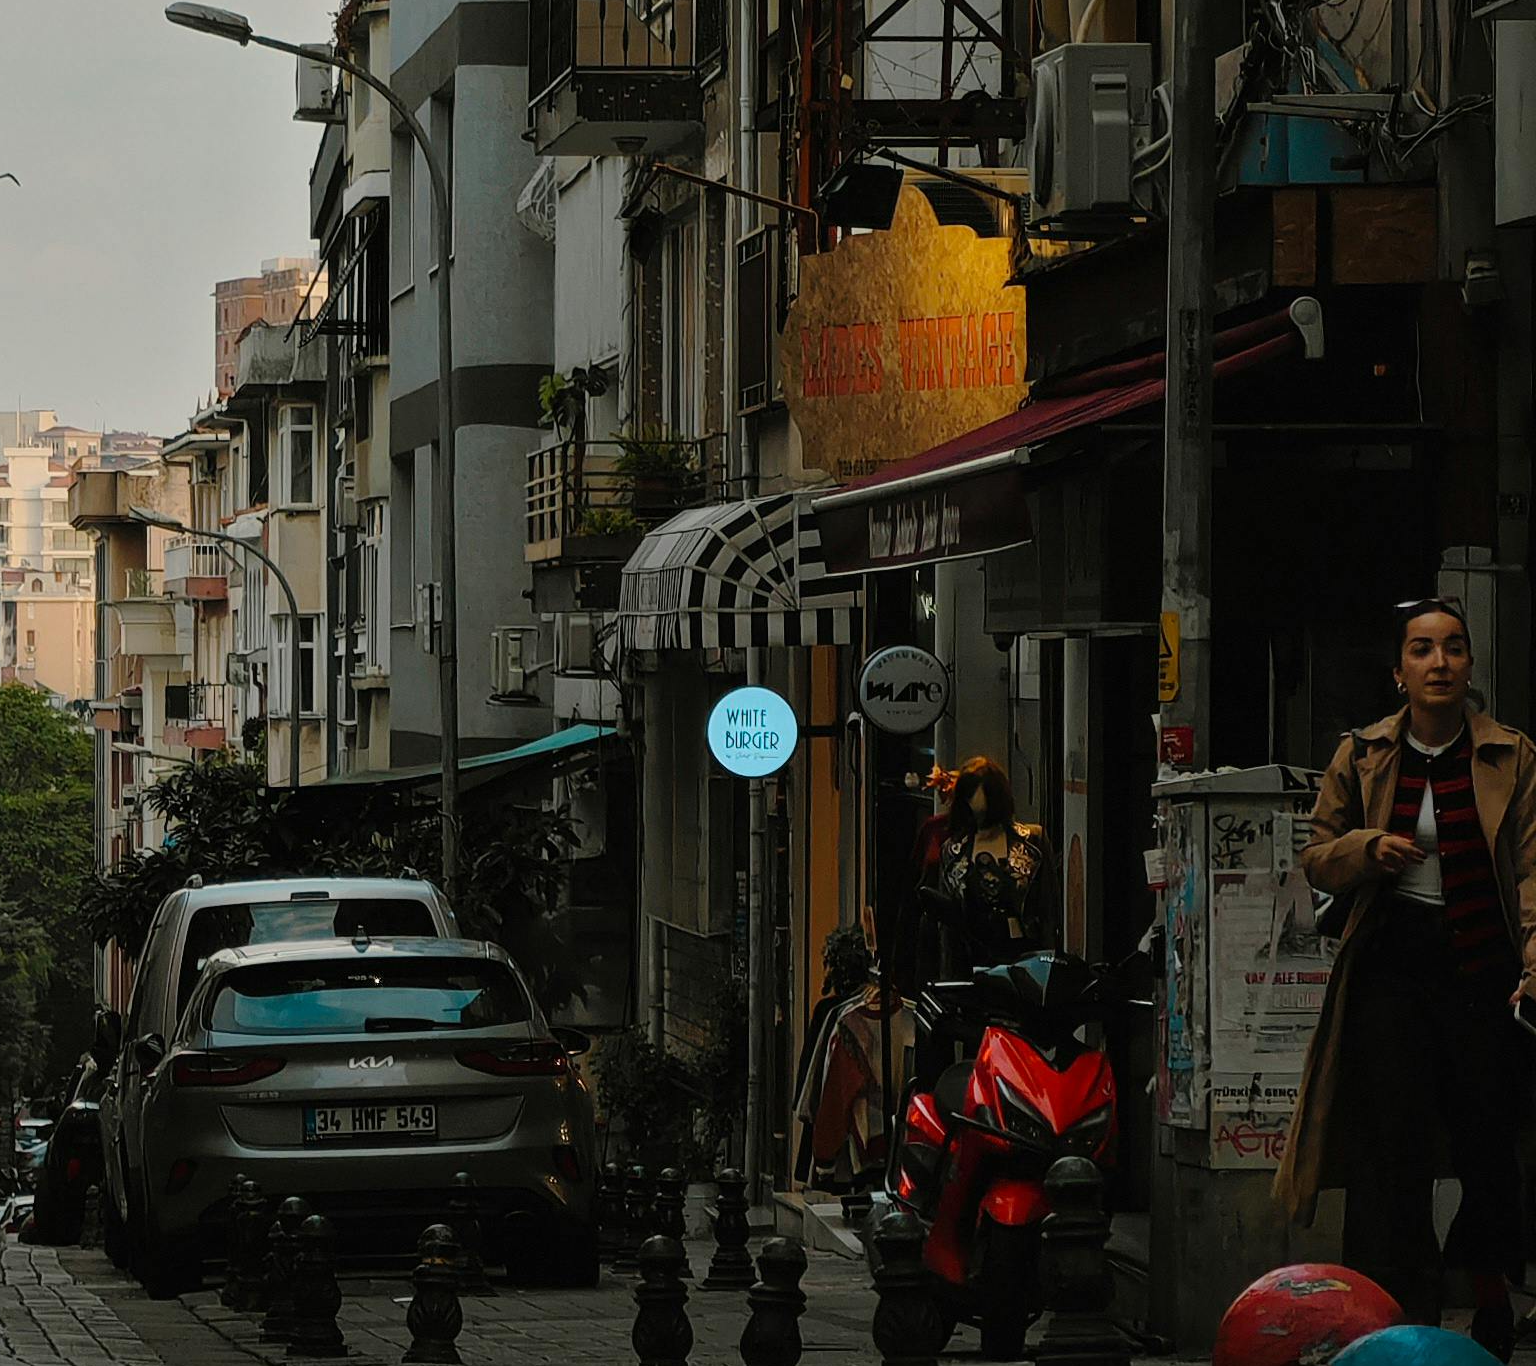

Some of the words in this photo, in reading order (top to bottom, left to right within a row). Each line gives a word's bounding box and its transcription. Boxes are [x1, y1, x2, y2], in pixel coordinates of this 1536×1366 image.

[898, 311, 1016, 392] VINTAGE
[726, 708, 767, 728] WHITE
[725, 730, 780, 750] BURGER
[316, 1110, 341, 1132] 34
[351, 1108, 388, 1131] HMF
[396, 1106, 434, 1129] 549
